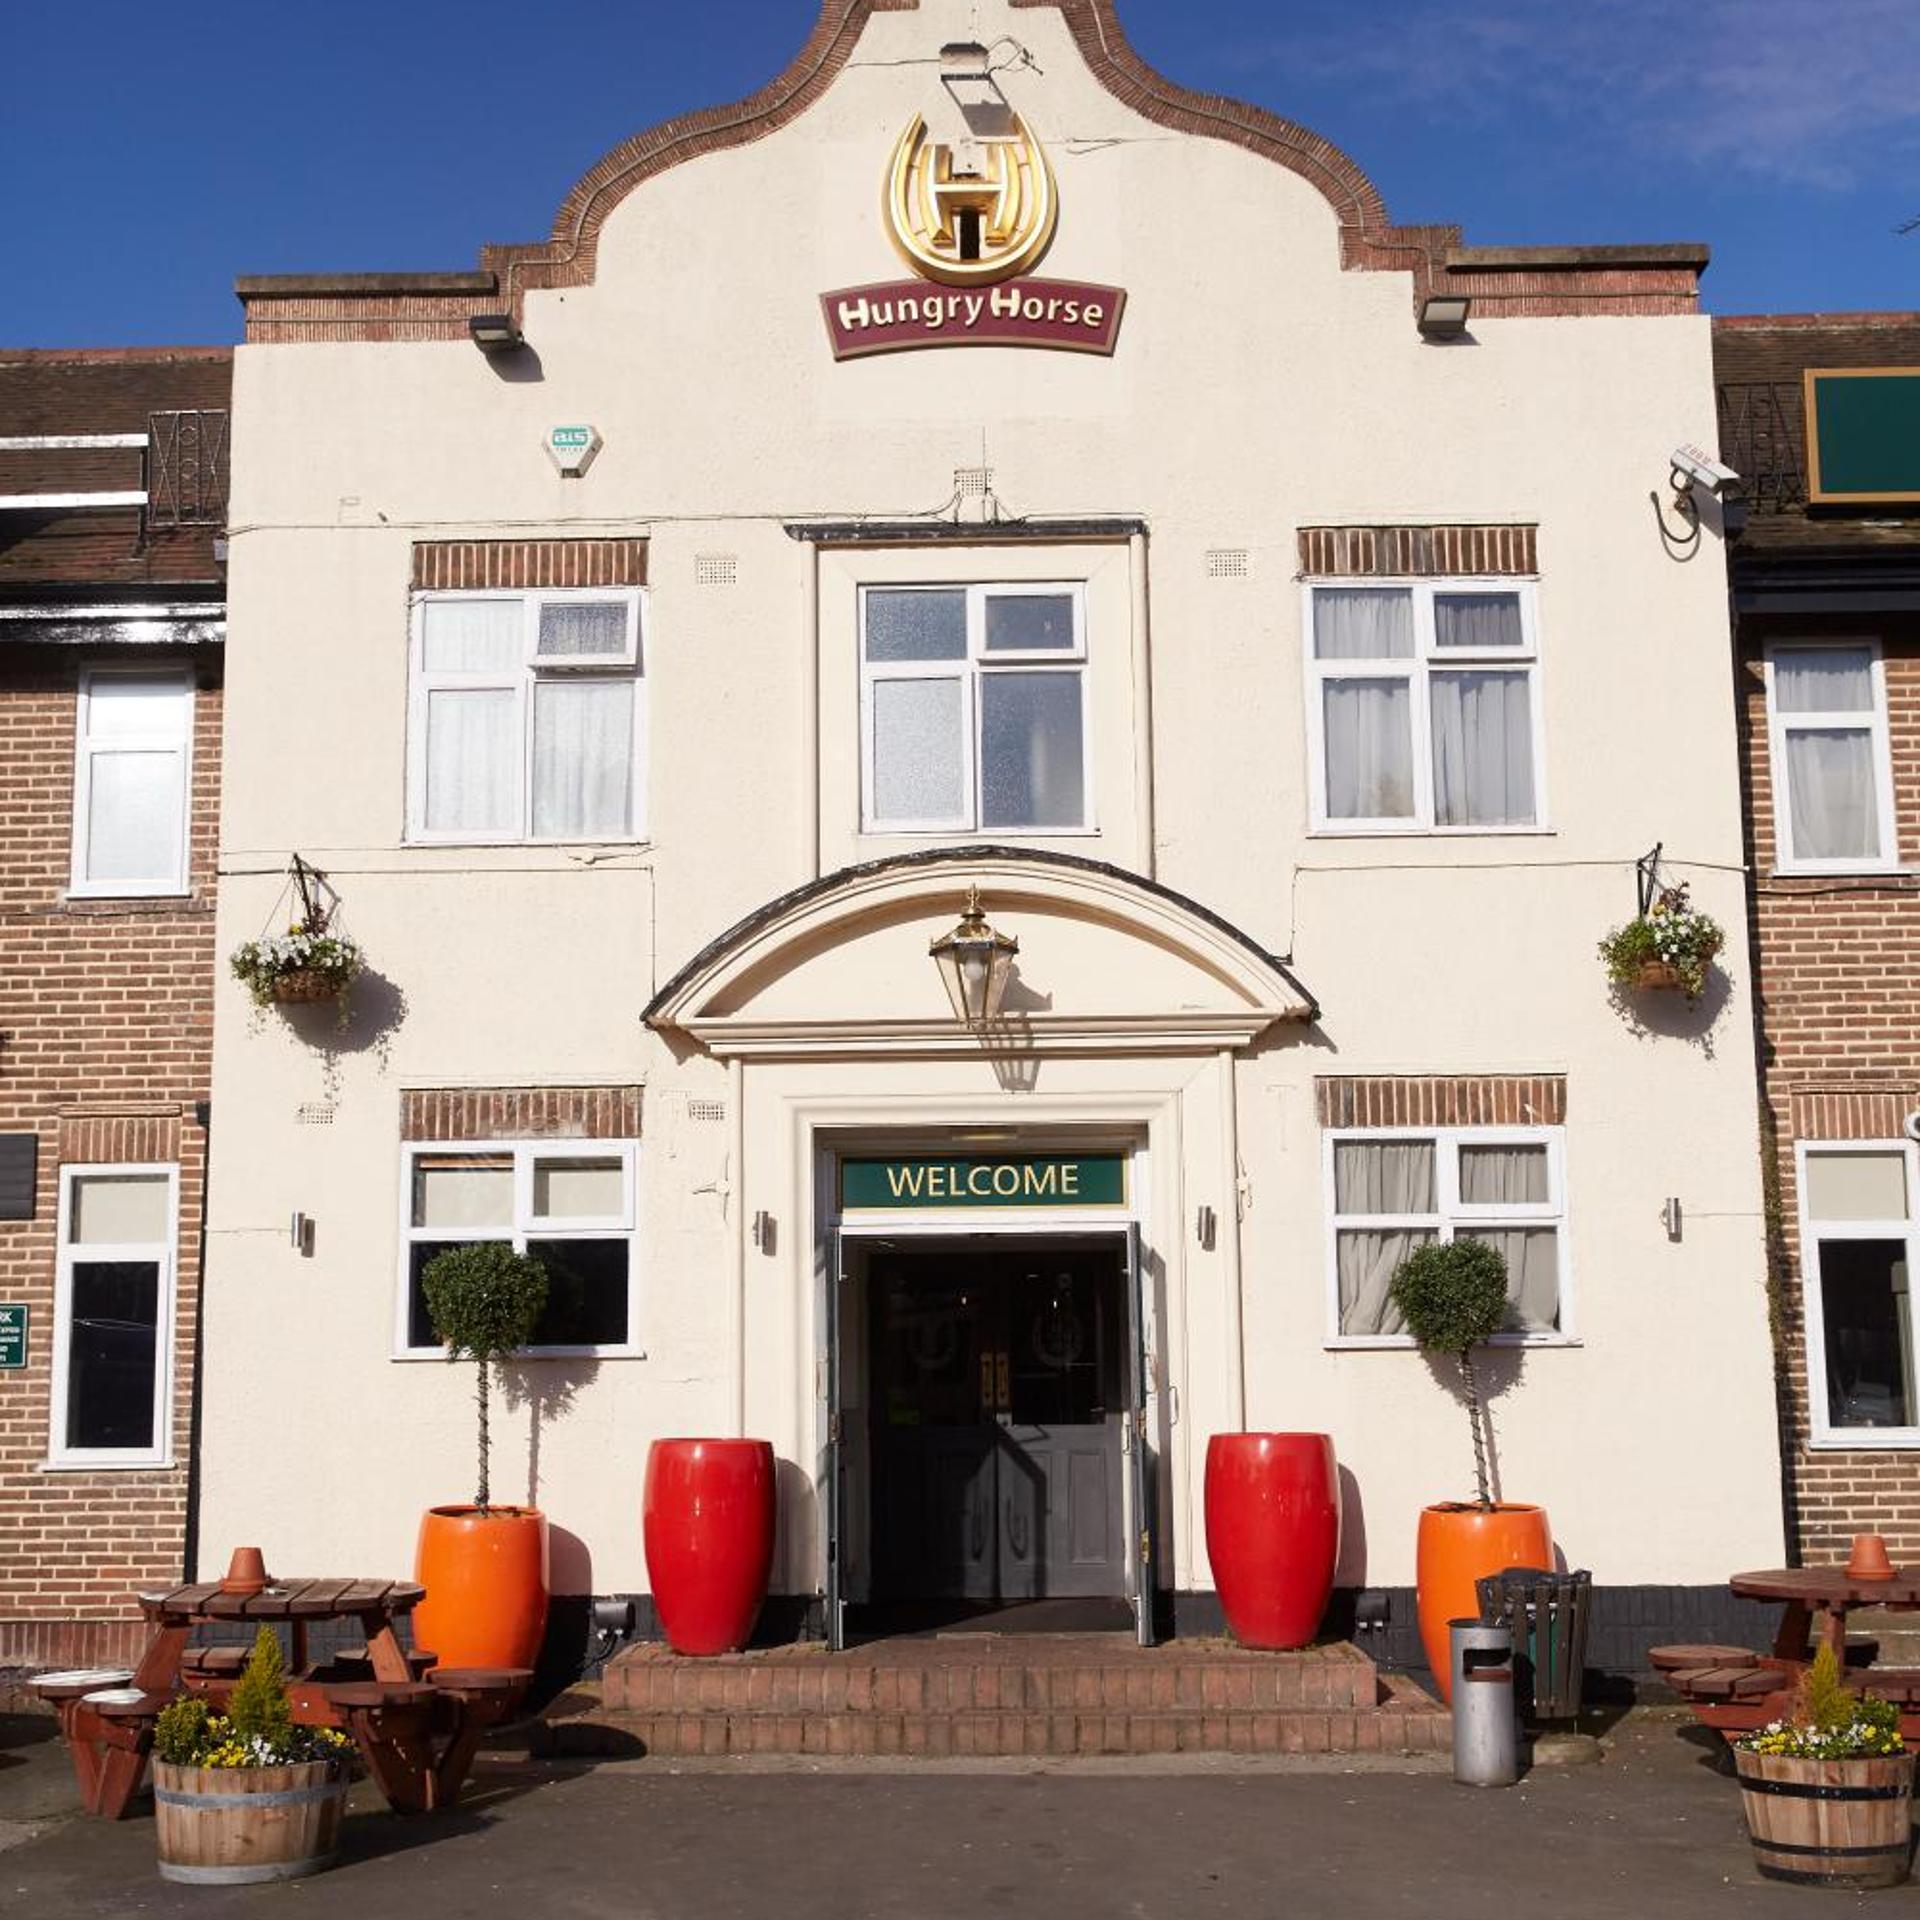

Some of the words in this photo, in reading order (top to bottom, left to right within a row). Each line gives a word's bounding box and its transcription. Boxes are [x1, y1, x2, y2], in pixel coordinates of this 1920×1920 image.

[838, 293, 985, 331] Hungry
[990, 287, 1104, 327] Horse
[886, 1164, 1080, 1197] WELCOME
